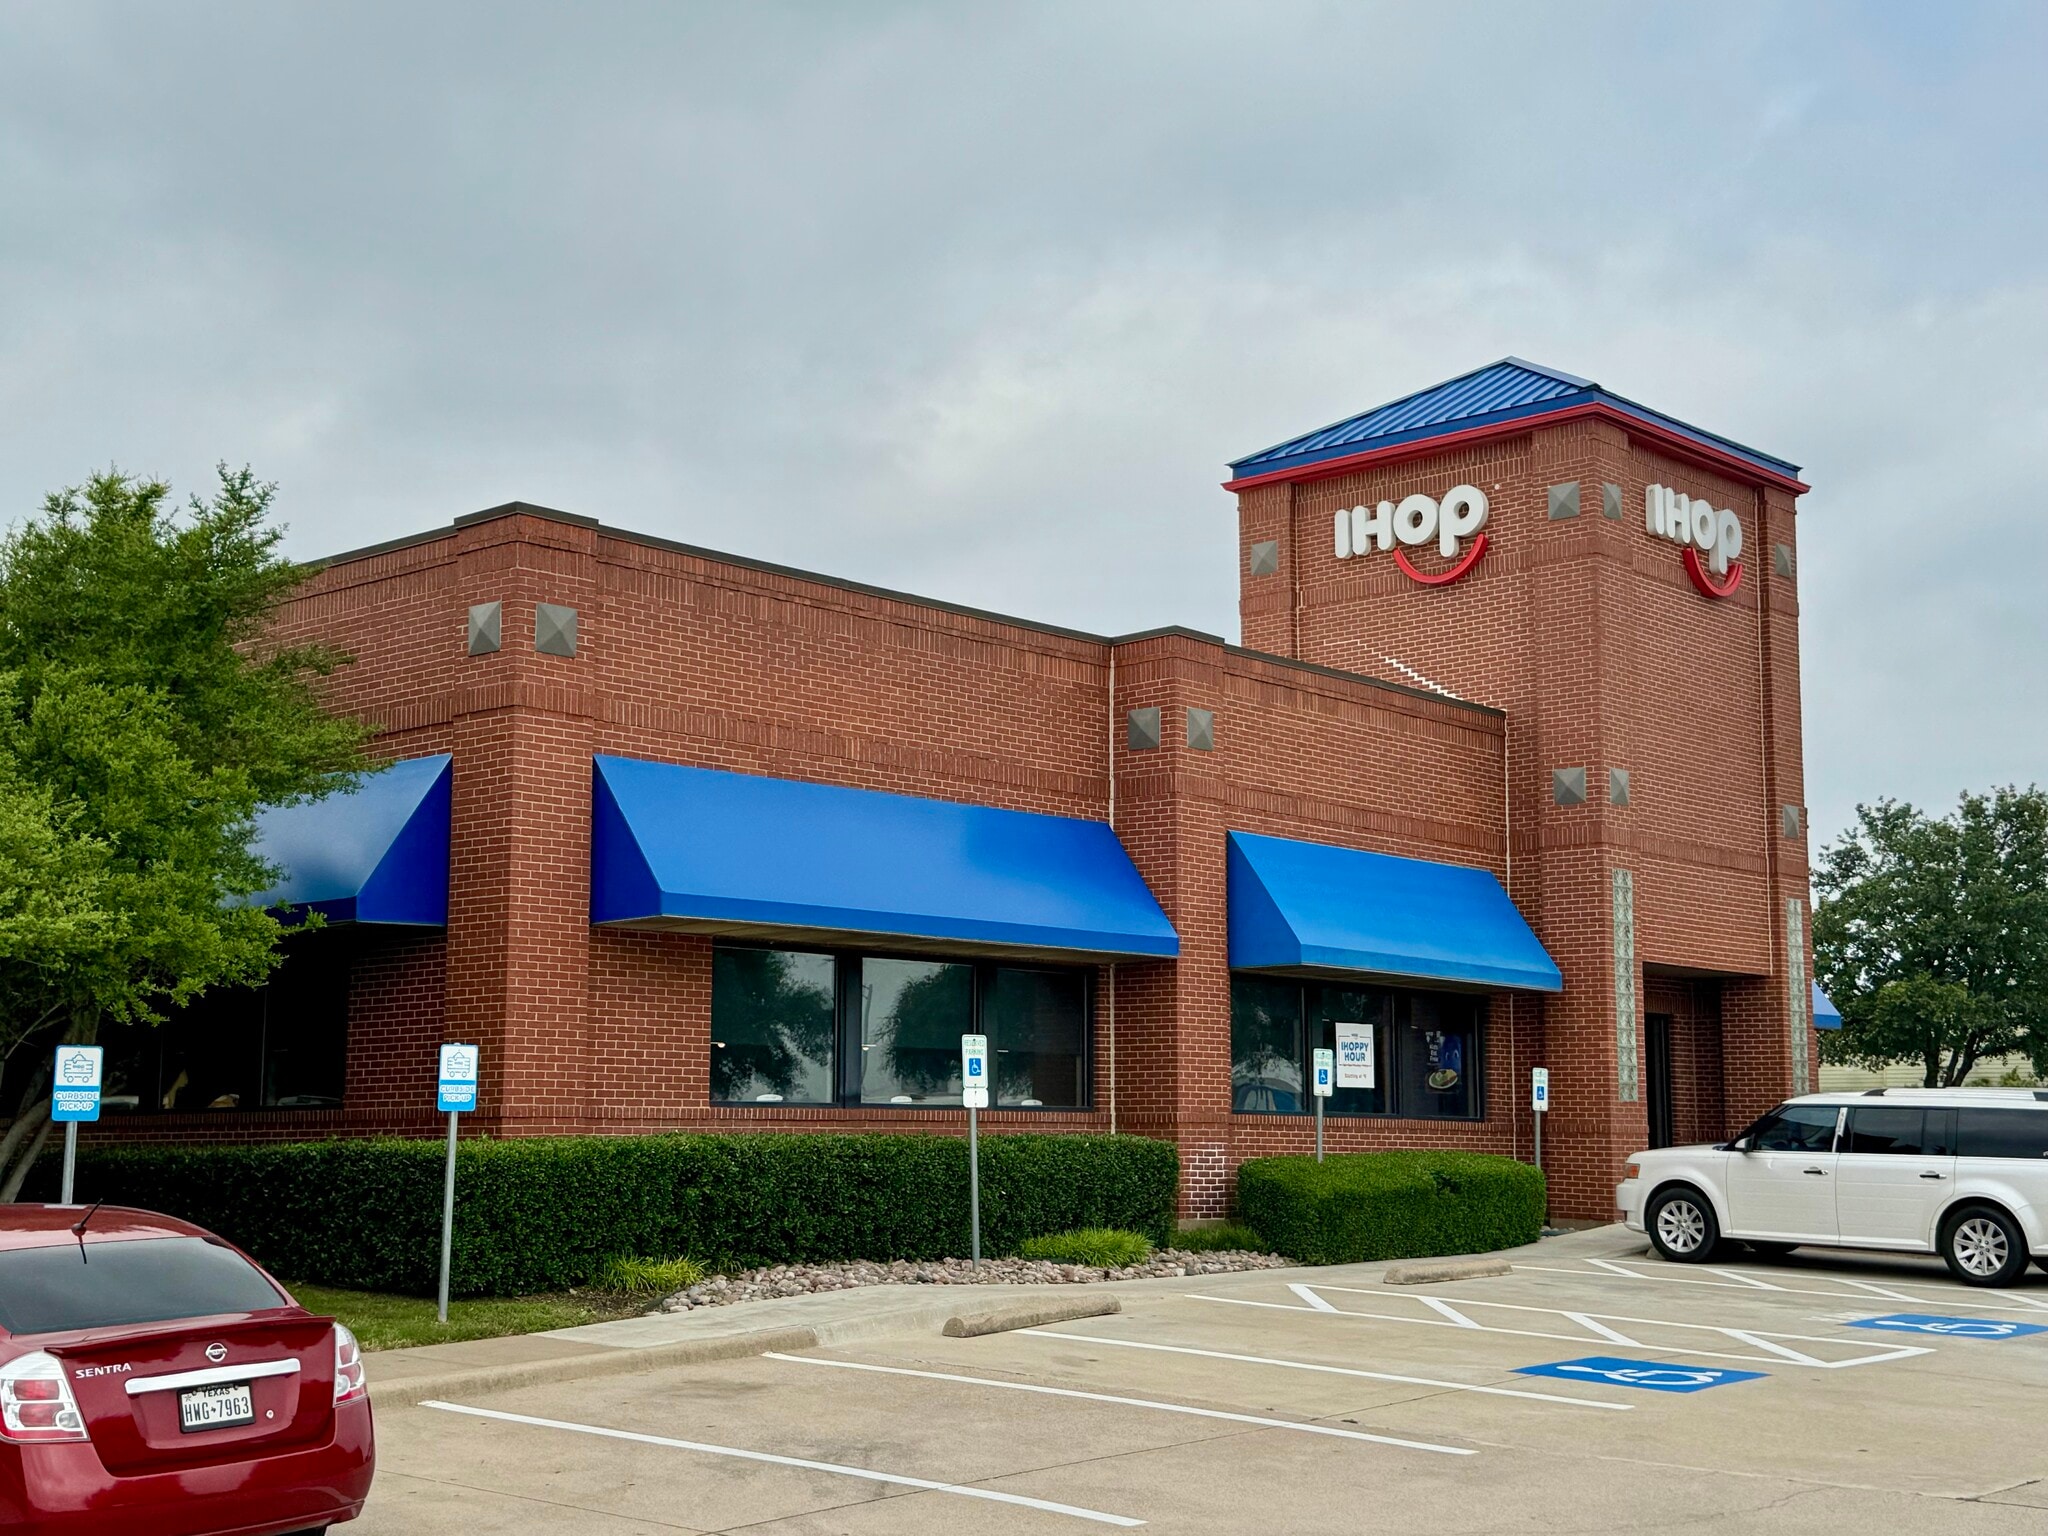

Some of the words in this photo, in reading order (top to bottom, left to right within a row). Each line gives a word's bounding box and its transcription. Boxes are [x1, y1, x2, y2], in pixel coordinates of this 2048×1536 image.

[1334, 484, 1489, 559] IHOP
[1645, 483, 1742, 575] IHOP
[1341, 1041, 1369, 1052] IHOPPY
[1344, 1052, 1366, 1062] HOUR
[55, 1092, 98, 1100] CURBSIDE
[59, 1102, 94, 1110] PICK-UP
[75, 1362, 132, 1379] SENTRA
[202, 1388, 231, 1398] TEXAS
[217, 1397, 249, 1418] 7963
